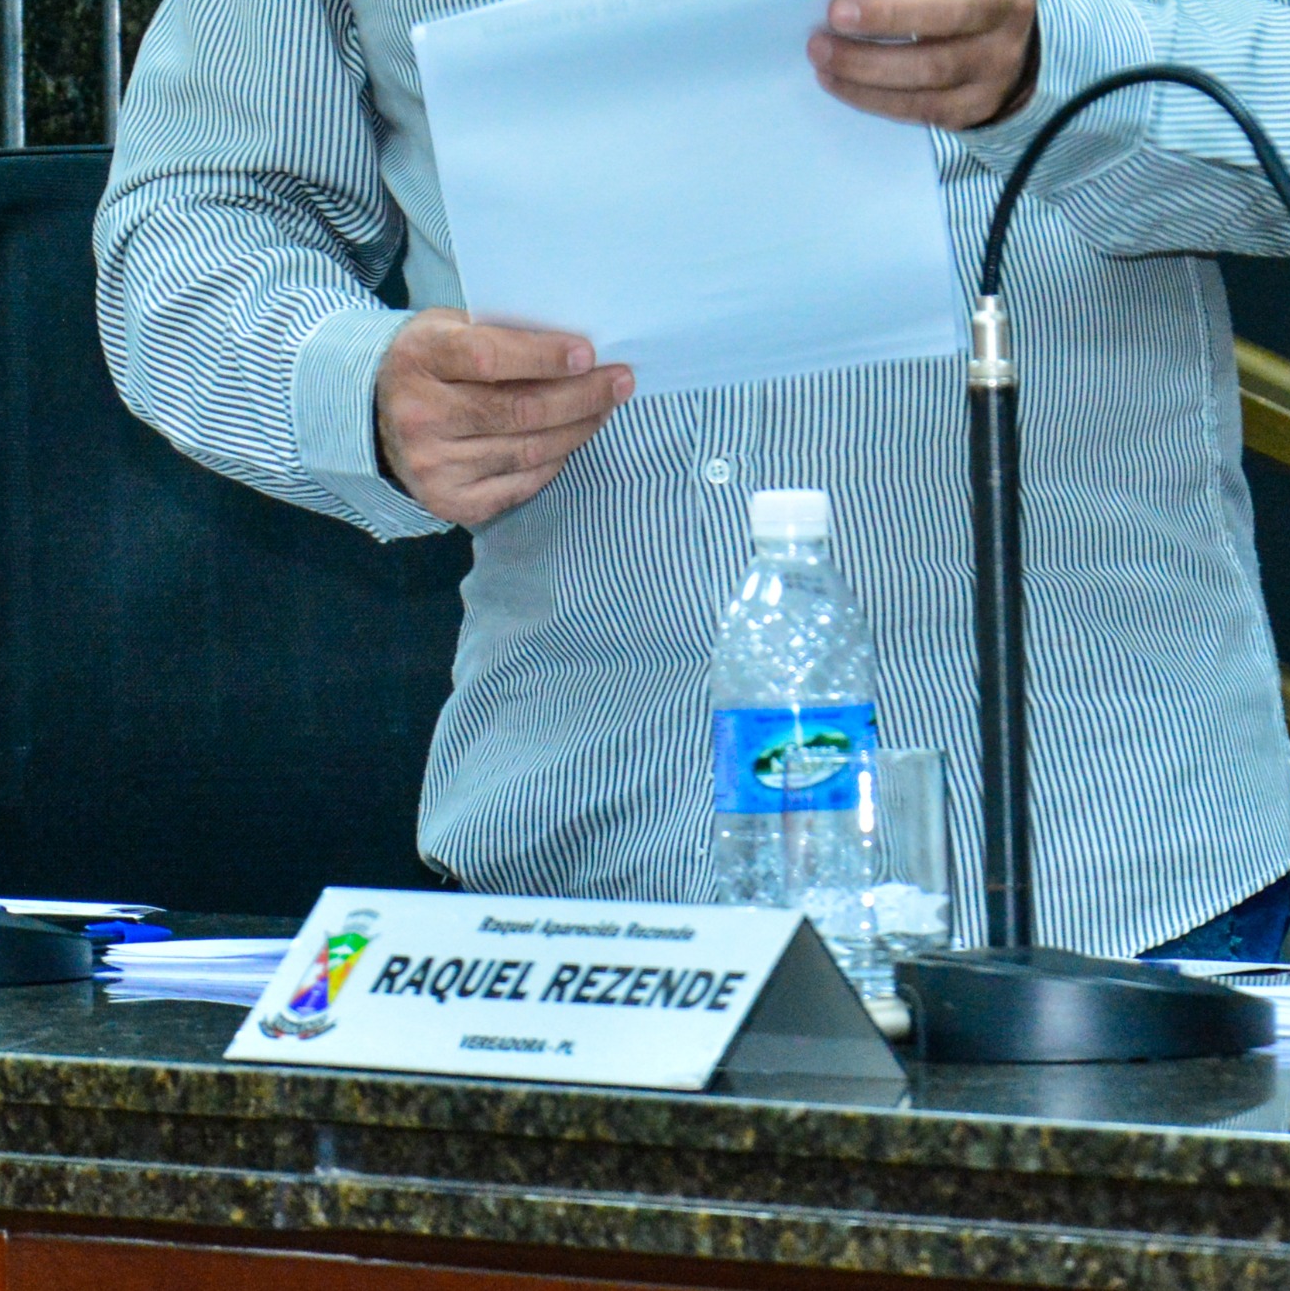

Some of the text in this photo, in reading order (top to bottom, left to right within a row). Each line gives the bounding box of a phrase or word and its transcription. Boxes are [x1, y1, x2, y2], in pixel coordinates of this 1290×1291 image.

[478, 915, 538, 936] Raquel
[369, 955, 747, 1012] RAQUEL REZENDE
[459, 1033, 547, 1054] VEREADORA
[555, 1039, 576, 1056] PL
